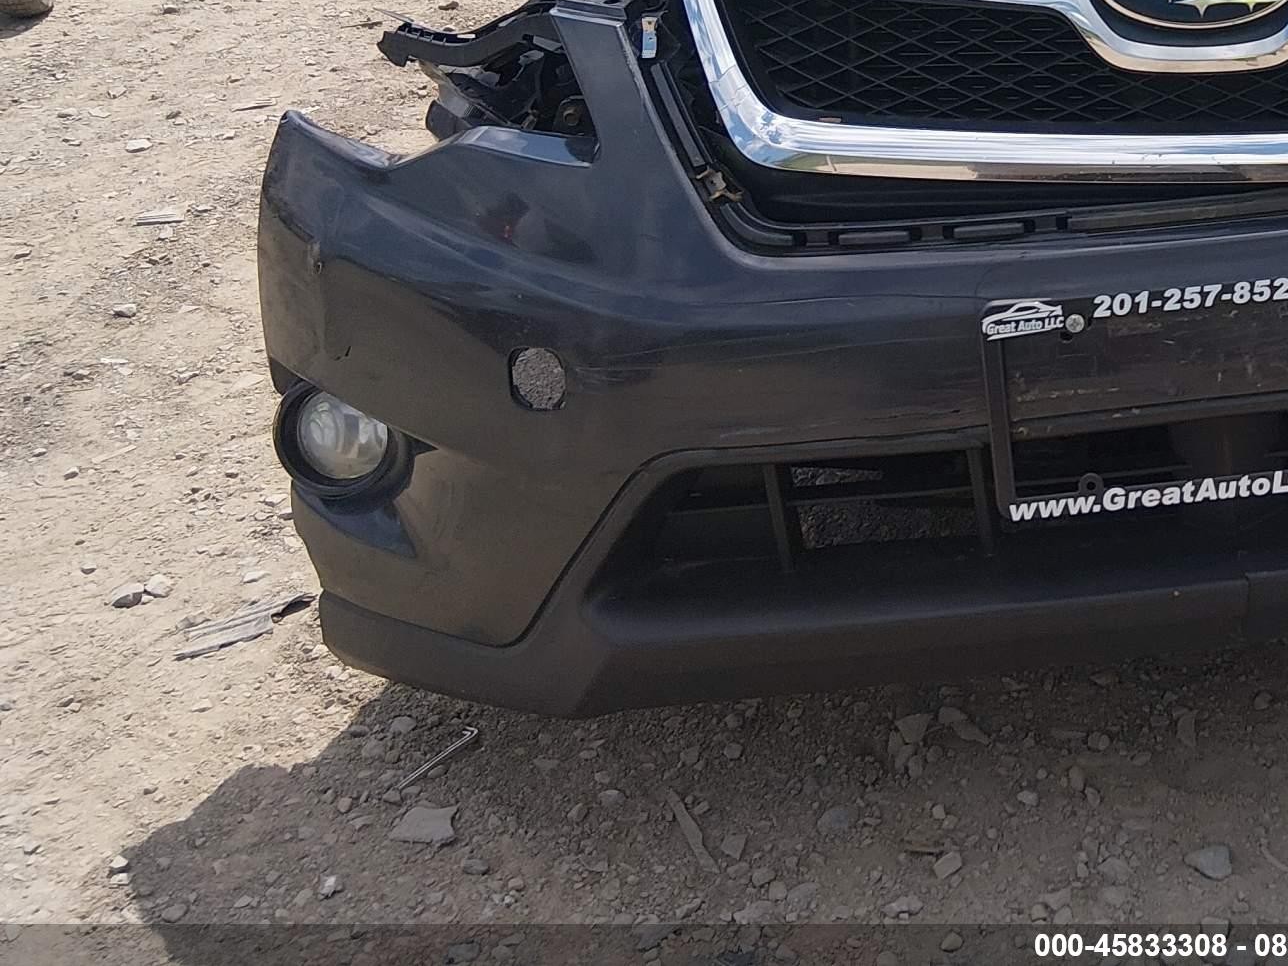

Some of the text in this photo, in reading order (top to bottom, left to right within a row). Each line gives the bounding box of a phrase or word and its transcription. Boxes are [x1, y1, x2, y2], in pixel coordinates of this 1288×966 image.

[987, 316, 1065, 335] Great Auto LLC
